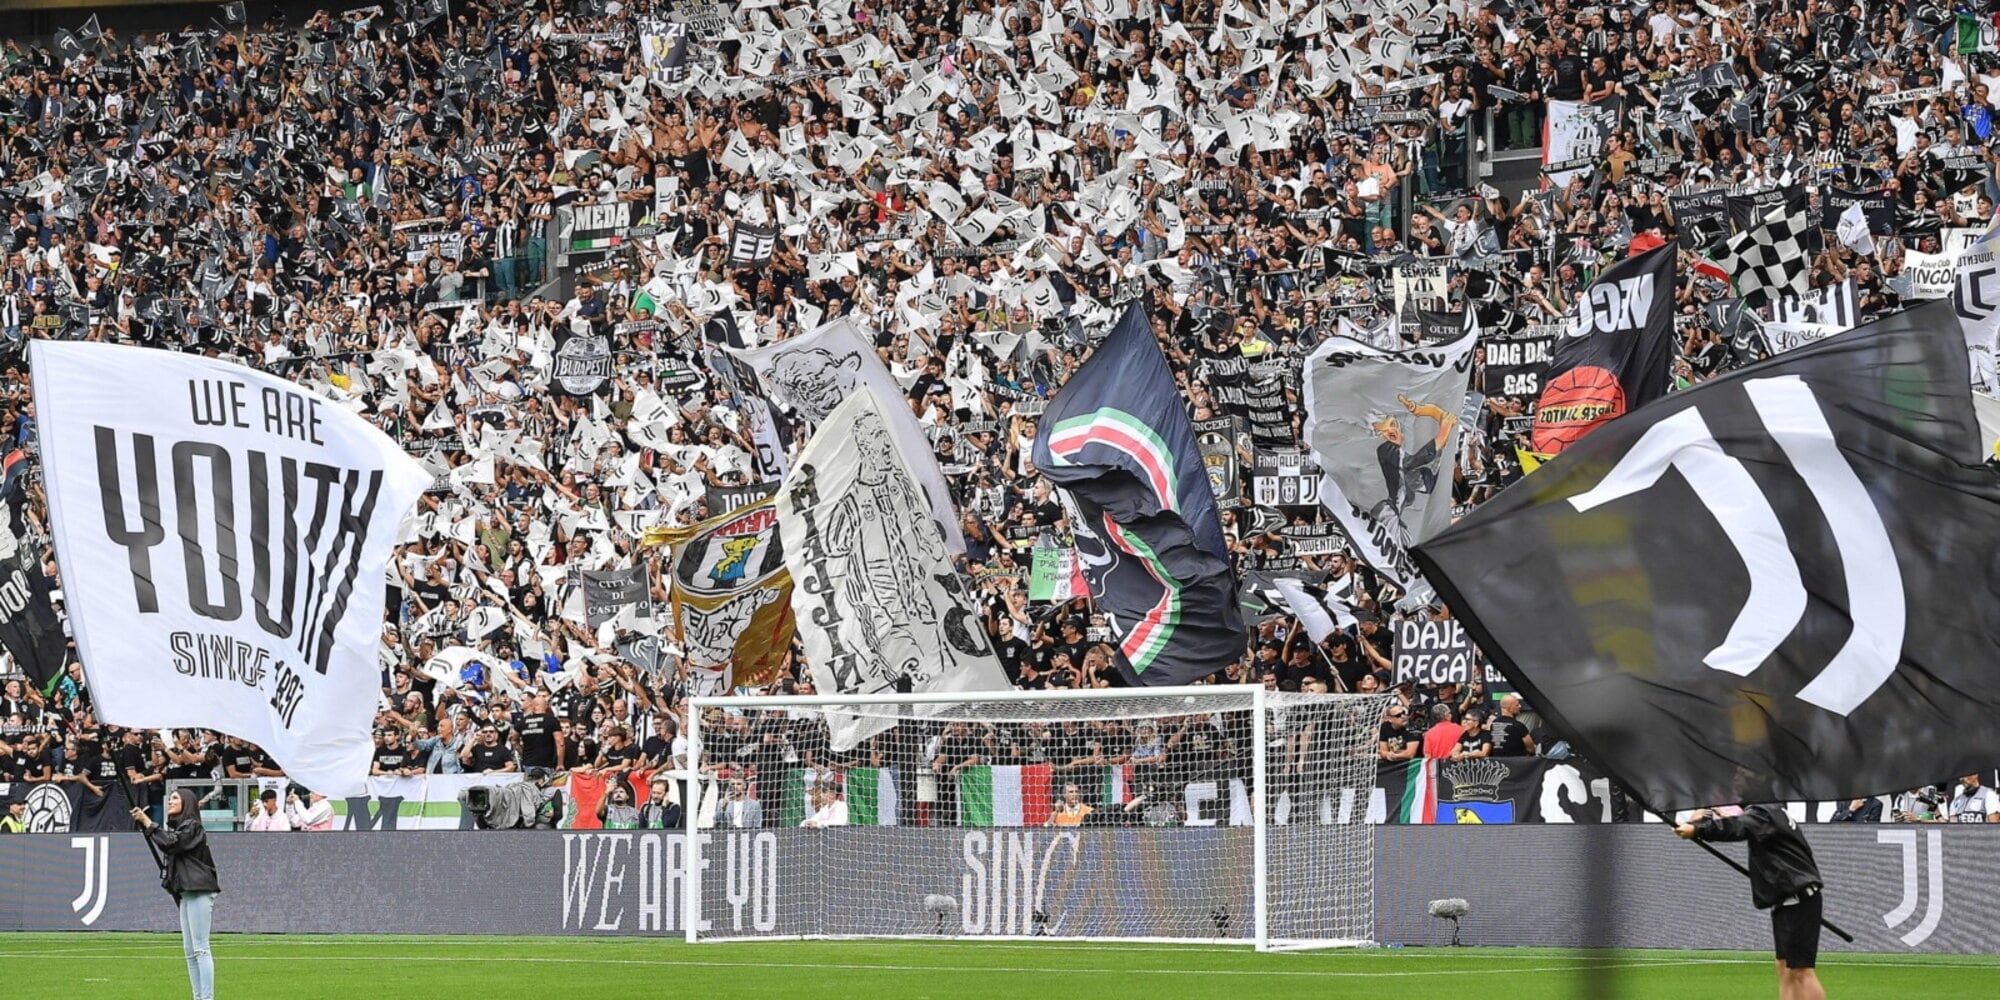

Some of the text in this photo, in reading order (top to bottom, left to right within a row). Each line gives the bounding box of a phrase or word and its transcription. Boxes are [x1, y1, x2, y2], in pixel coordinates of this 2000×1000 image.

[681, 5, 718, 17] GRUPPO
[638, 21, 686, 37] PAZZI
[1702, 194, 1724, 207] VAR
[575, 203, 630, 231] MEDA
[1400, 264, 1441, 279] SEMPRE
[1429, 325, 1461, 335] OLTRE
[1487, 343, 1522, 365] DAG
[560, 358, 606, 377] BUDAPEST
[1503, 373, 1538, 395] GAS
[189, 379, 325, 446] WE ARE
[1258, 455, 1278, 468] FINO
[1279, 455, 1299, 468] ALLA
[94, 425, 384, 675] YOUTH
[1299, 534, 1345, 551] JUVENTUS
[598, 575, 635, 589] CITTÀ
[611, 590, 625, 601] DI
[587, 600, 649, 616] CASTO
[1401, 619, 1467, 650] DAJE
[170, 631, 305, 730] SINCE 1897
[562, 832, 778, 932] WE ARE YO
[961, 830, 1081, 936] SINC
